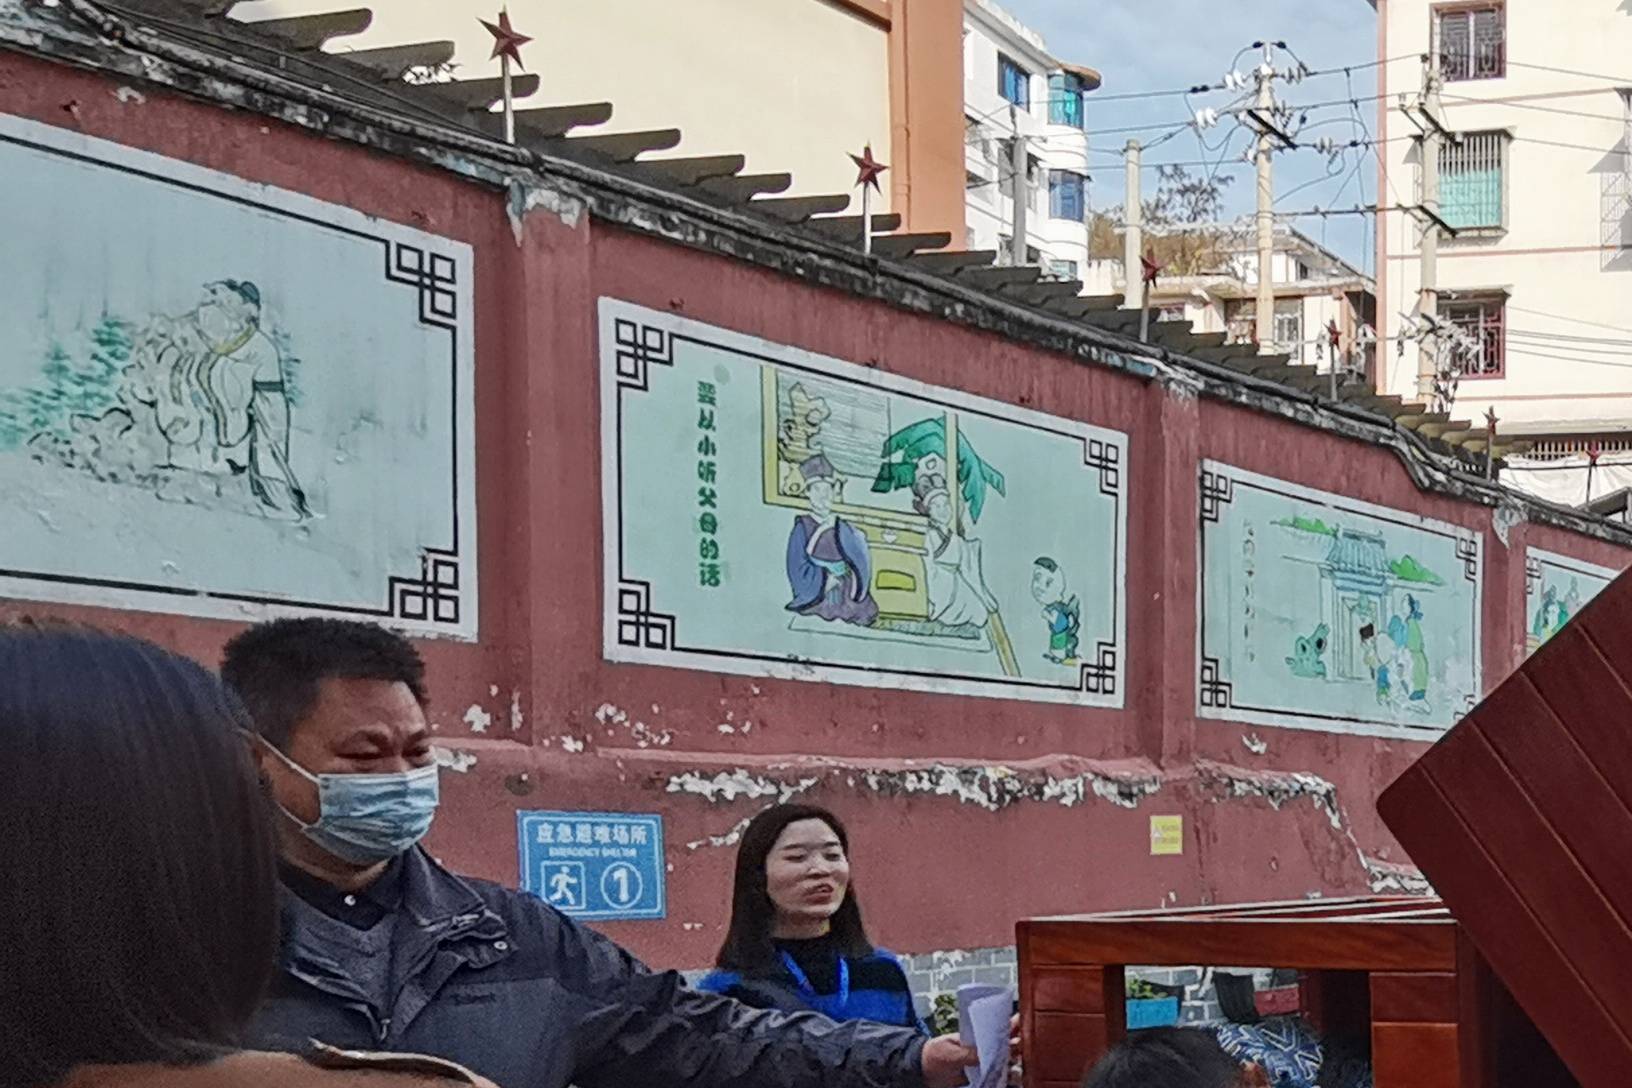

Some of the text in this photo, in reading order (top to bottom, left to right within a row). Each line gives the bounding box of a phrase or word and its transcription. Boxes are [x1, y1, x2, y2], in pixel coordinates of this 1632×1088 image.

[536, 822, 648, 845] 应急避难场所
[613, 868, 630, 903] 1
